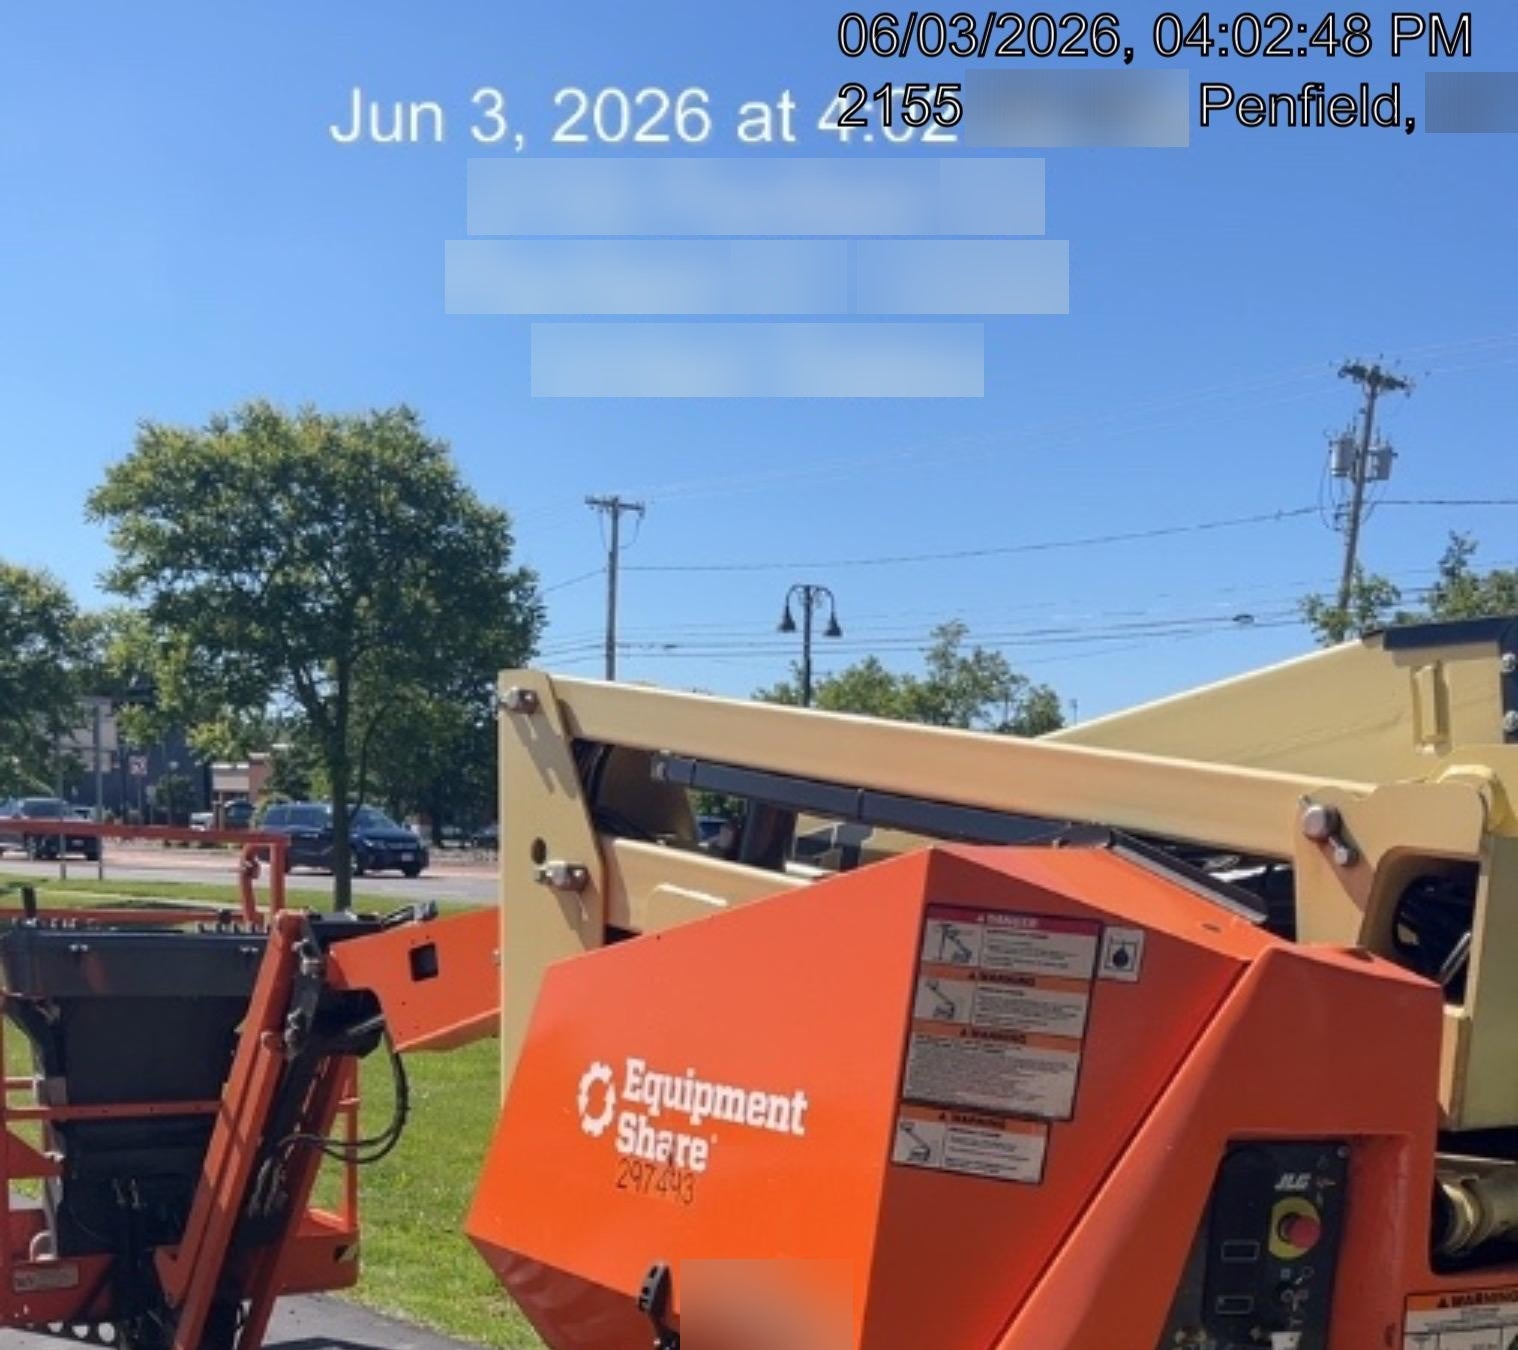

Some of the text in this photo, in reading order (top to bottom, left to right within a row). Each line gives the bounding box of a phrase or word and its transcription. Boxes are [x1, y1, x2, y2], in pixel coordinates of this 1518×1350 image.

[622, 1057, 808, 1136] Equipment
[614, 1111, 710, 1173] Share
[1274, 1172, 1312, 1192] JLG
